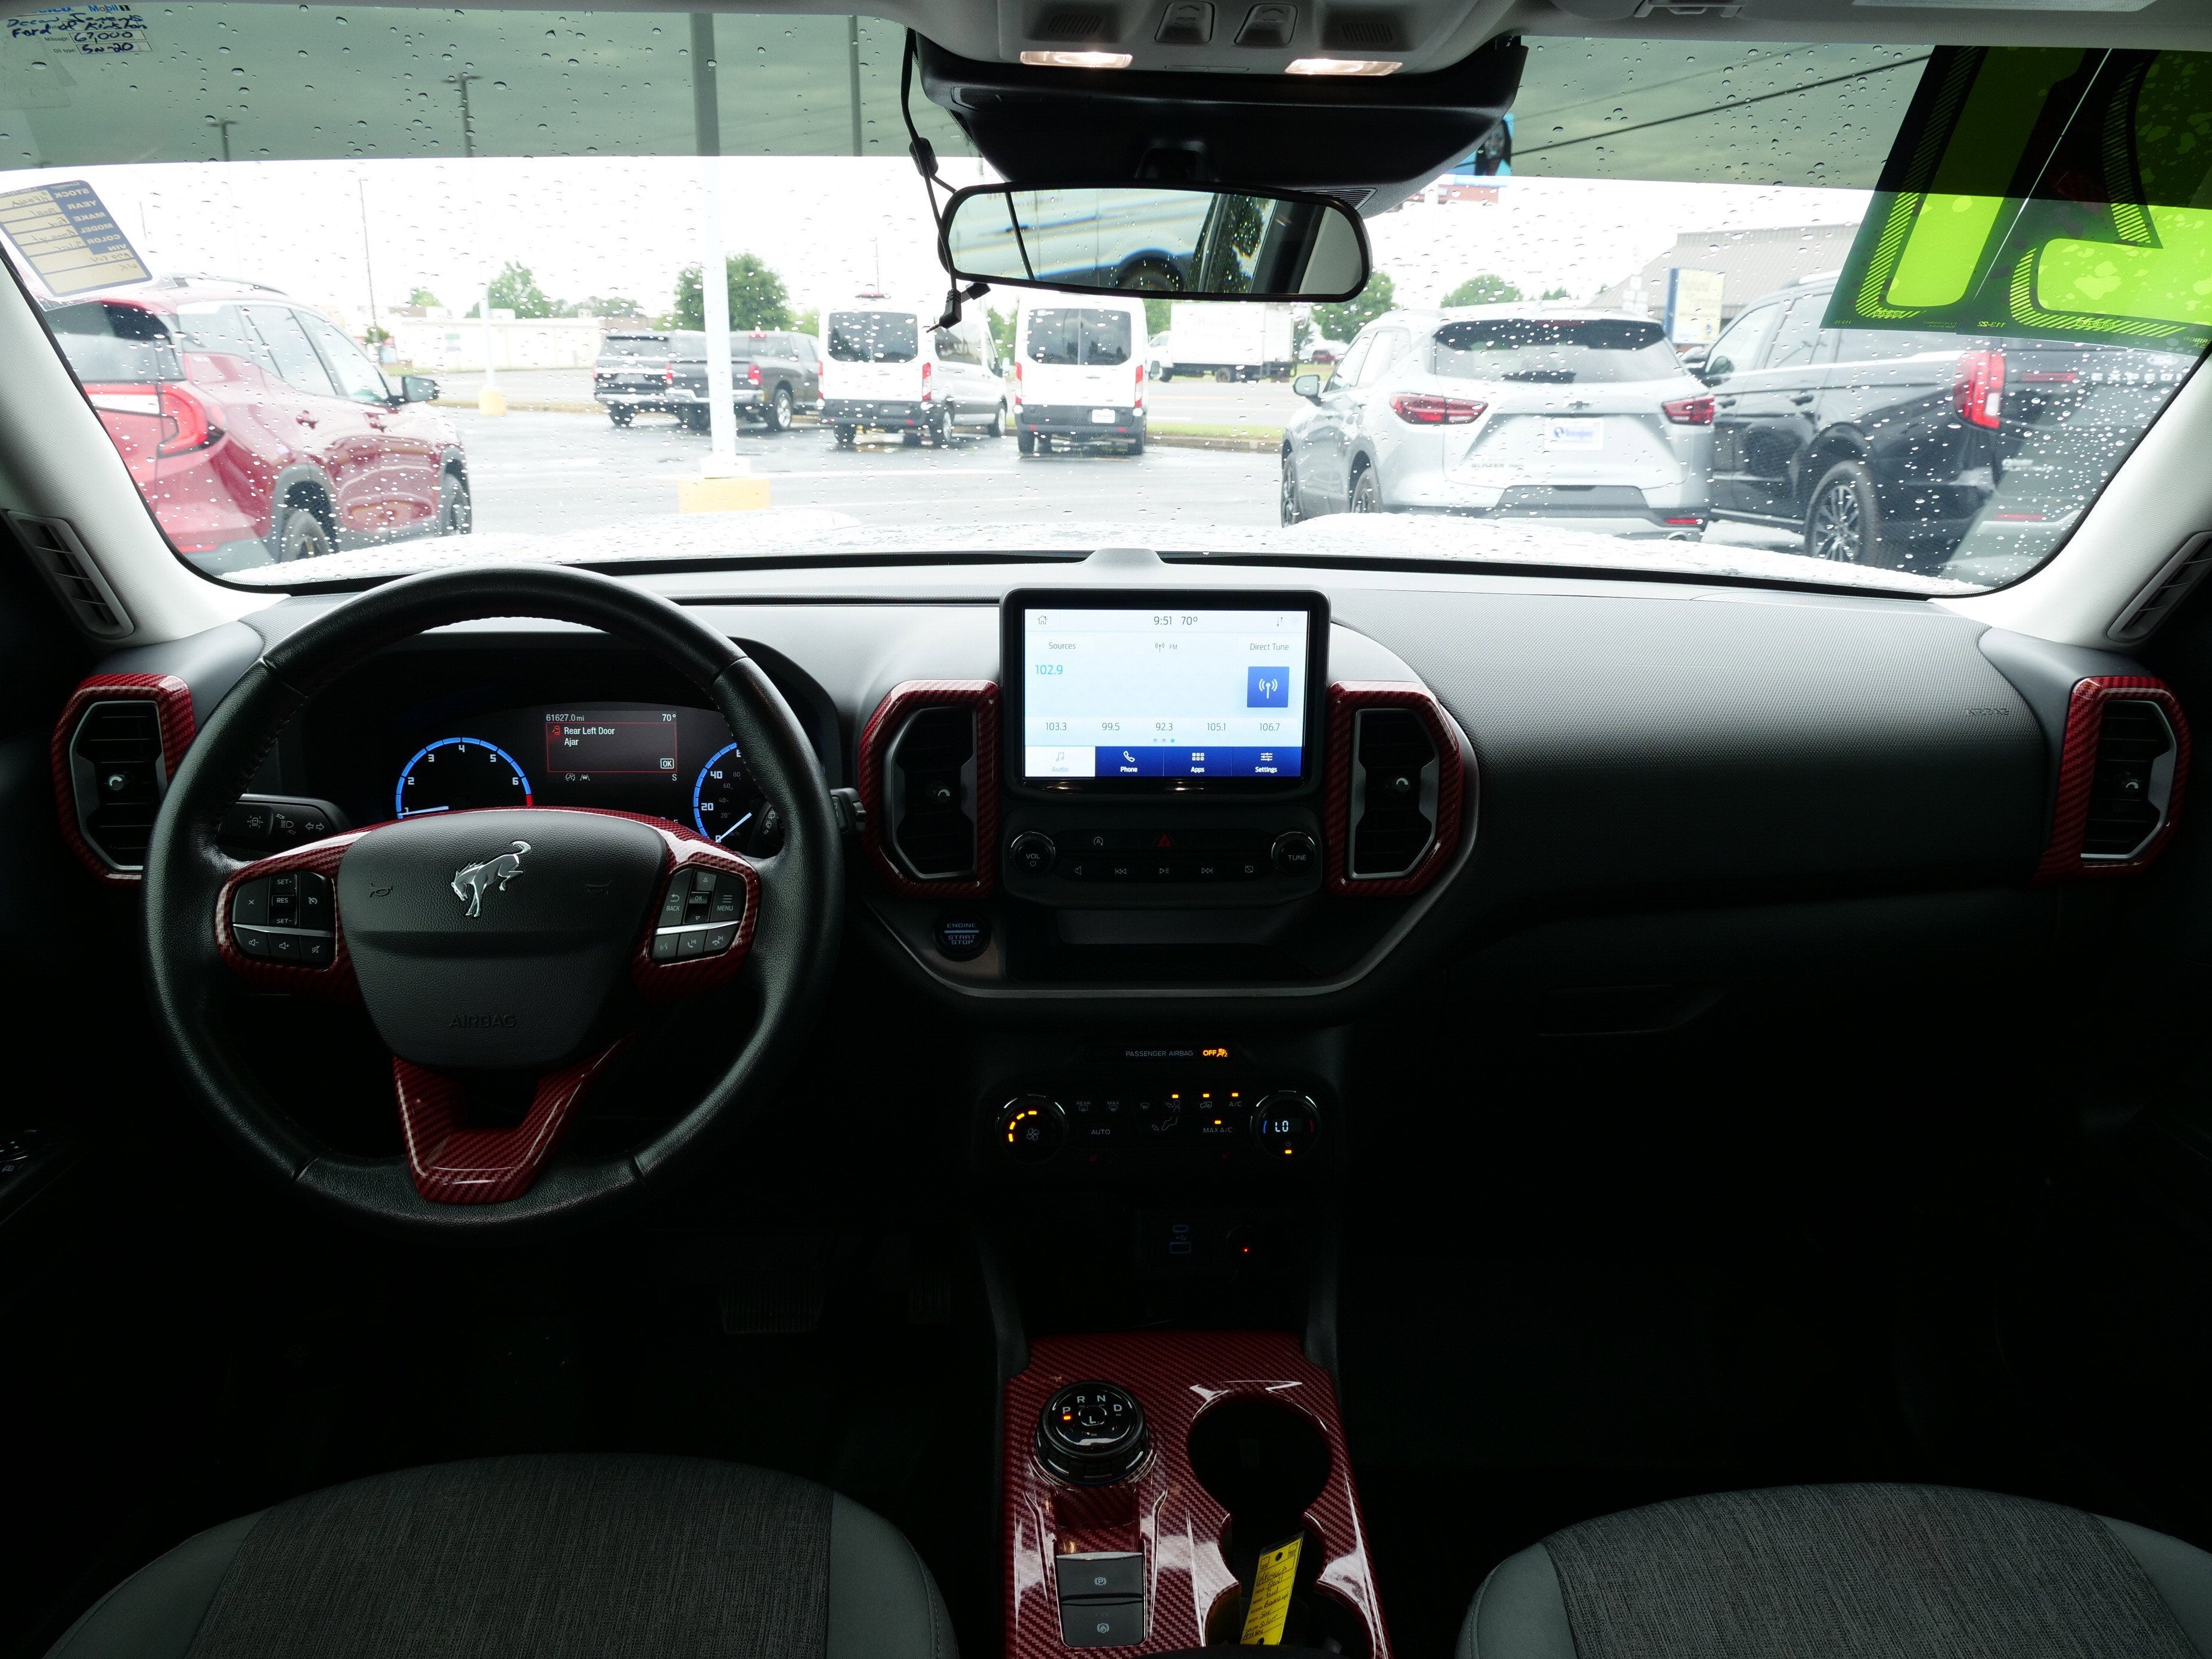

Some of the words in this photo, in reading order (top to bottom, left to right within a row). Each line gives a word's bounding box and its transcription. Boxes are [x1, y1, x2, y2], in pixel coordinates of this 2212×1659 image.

[12, 23, 52, 38] Ford
[1153, 616, 1173, 625] 9:51
[1250, 642, 1270, 651] Direct
[1272, 642, 1289, 651] Tune
[1035, 665, 1063, 675] 102.9
[1045, 722, 1067, 731] 103.3
[1101, 722, 1120, 731] 99.5
[1155, 722, 1173, 731] 92.3
[1207, 722, 1226, 731] 105.1
[1259, 722, 1280, 731] 106.7
[564, 738, 579, 747] Ajar
[428, 754, 434, 762] 3
[490, 754, 496, 762] 5
[710, 771, 723, 779] 40
[1191, 766, 1205, 775] Apps
[1255, 766, 1278, 775] Settings
[512, 777, 518, 785] 6
[701, 803, 714, 811] 20
[448, 1013, 517, 1029] AIRBAG
[1062, 1406, 1071, 1415] P
[1089, 1415, 1096, 1424] L
